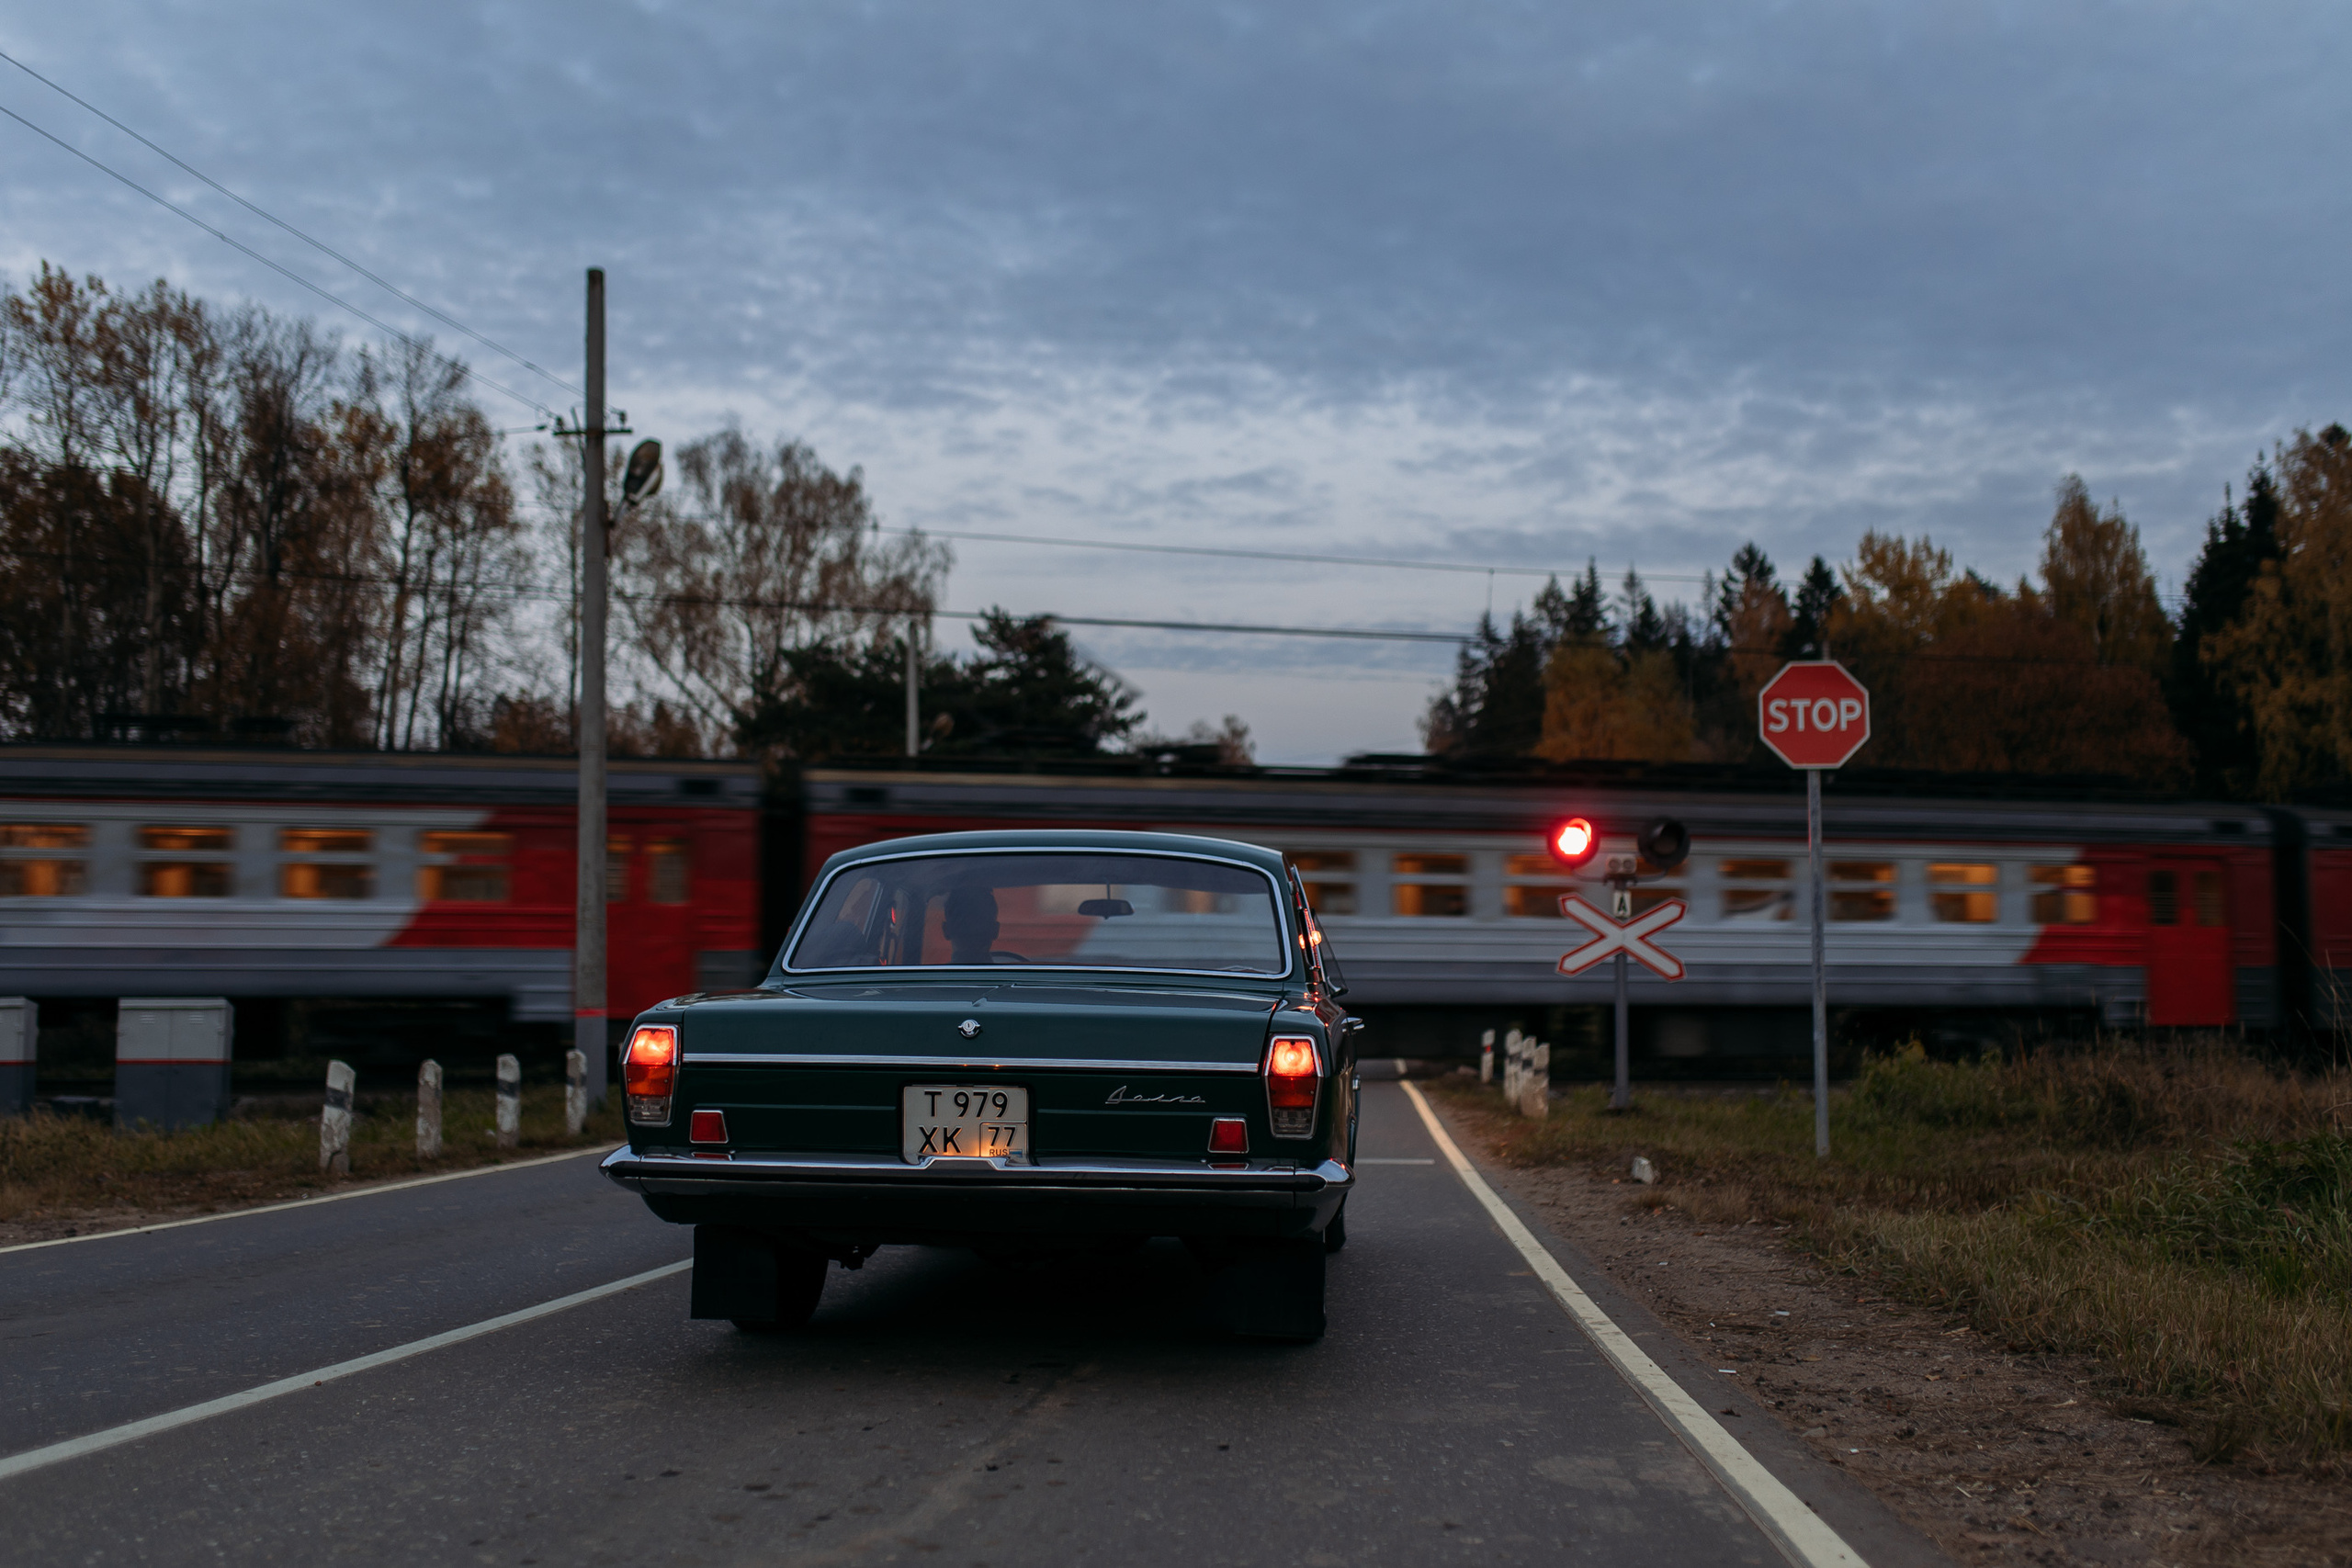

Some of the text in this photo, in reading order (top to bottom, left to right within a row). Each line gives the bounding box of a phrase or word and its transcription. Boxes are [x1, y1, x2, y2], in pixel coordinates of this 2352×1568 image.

[1769, 698, 1862, 733] STOP
[954, 1090, 1008, 1118] 979
[988, 1125, 1016, 1147] 77
[989, 1148, 1009, 1156] RUS
